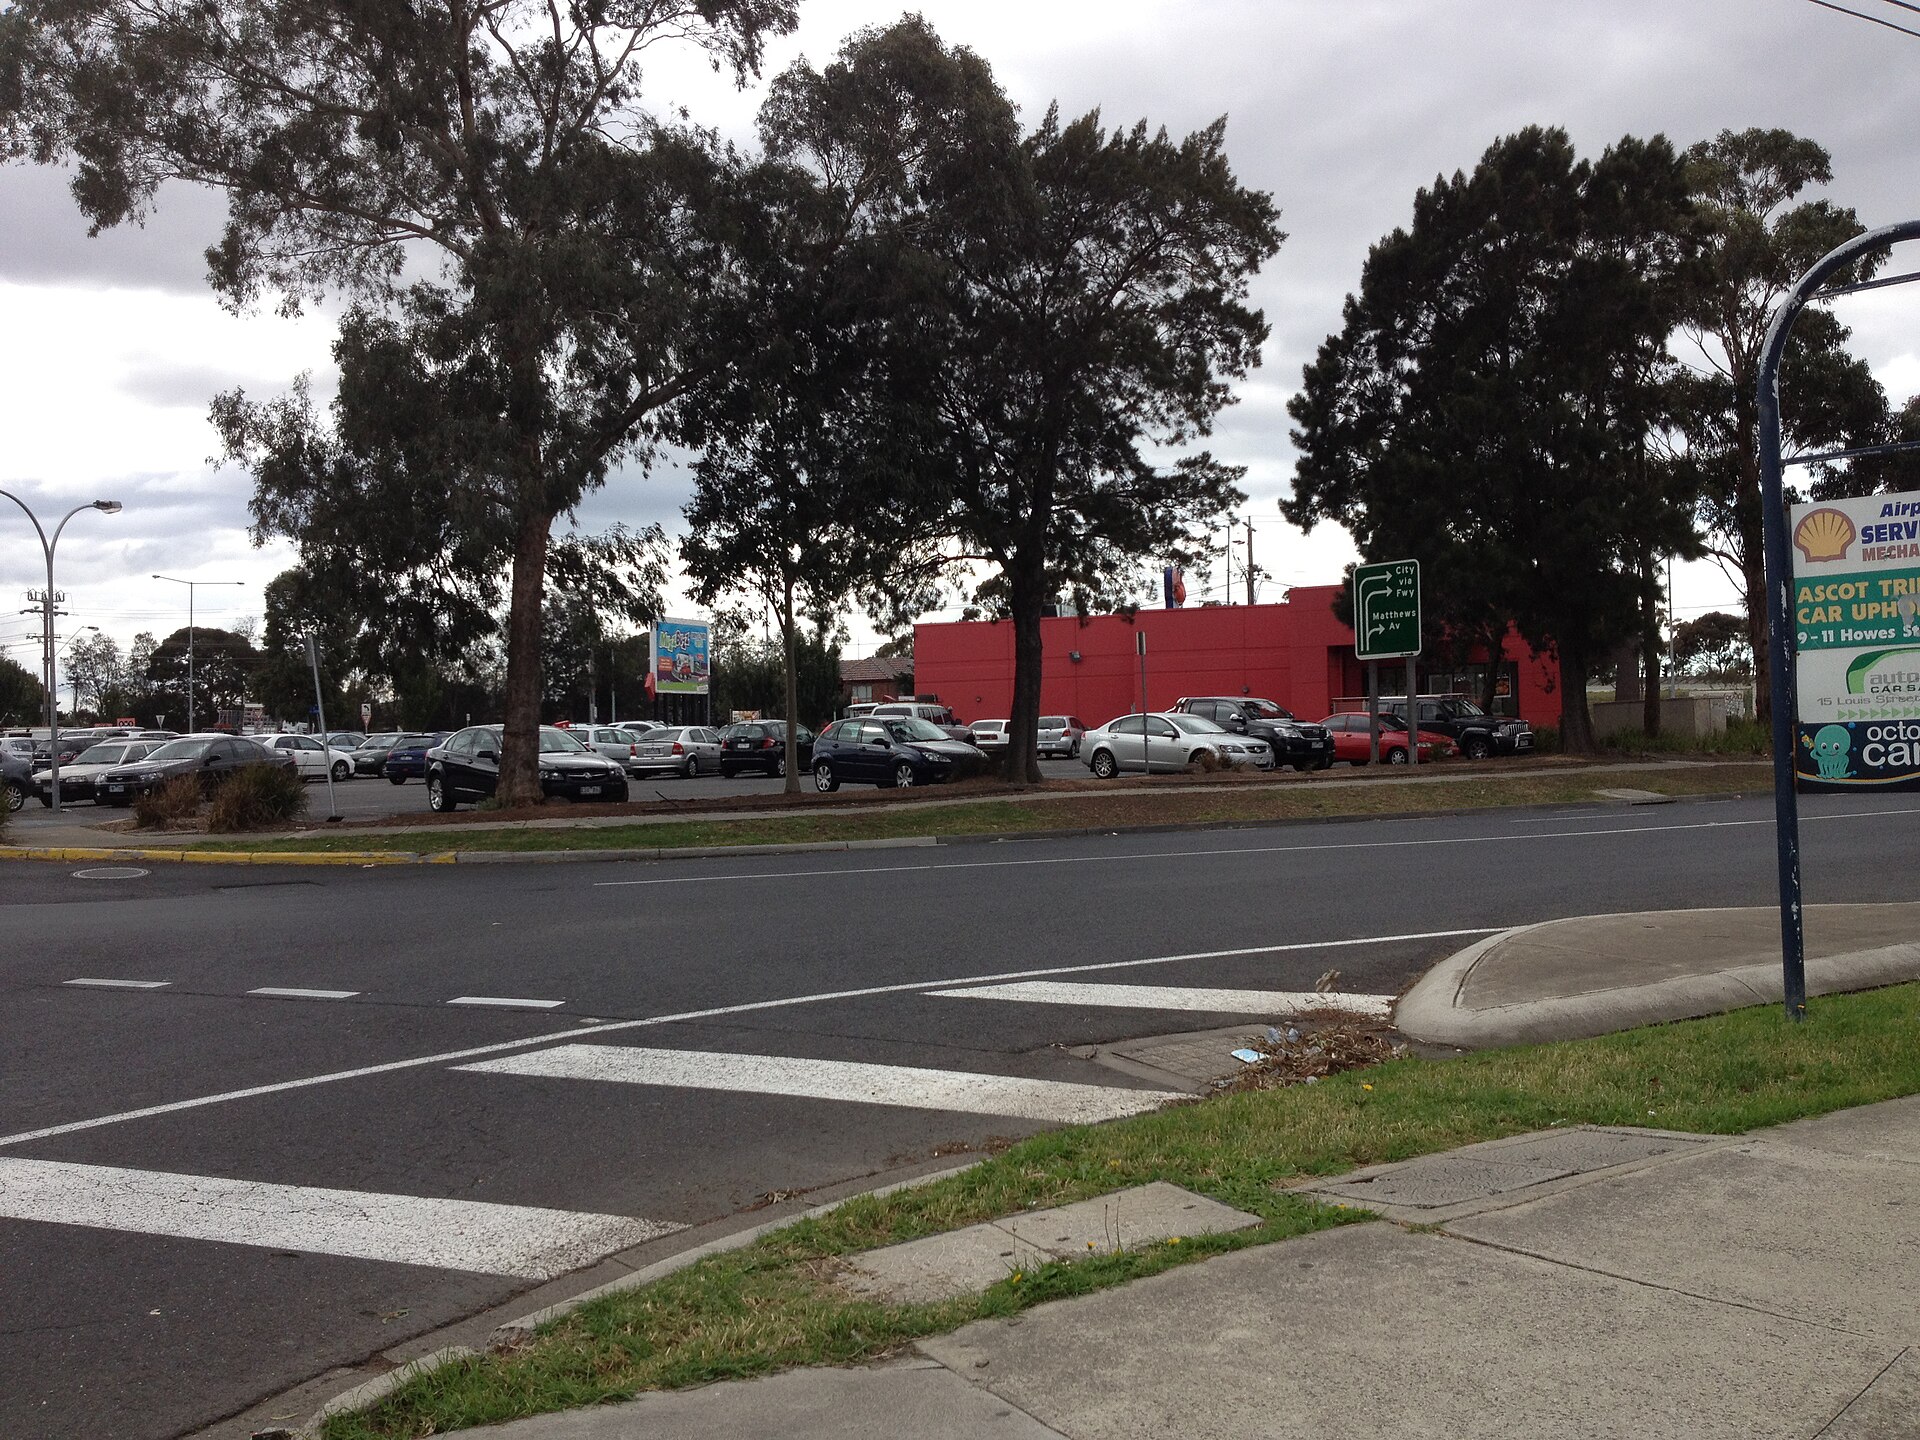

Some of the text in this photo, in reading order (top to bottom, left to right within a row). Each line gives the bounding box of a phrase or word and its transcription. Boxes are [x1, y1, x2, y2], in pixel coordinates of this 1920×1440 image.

[1880, 501, 1920, 518] Airp
[1861, 519, 1920, 545] SERV
[1862, 543, 1920, 562] MECHA
[1395, 566, 1415, 575] City
[1398, 577, 1413, 586] via
[1396, 588, 1415, 598] Fwy
[1797, 577, 1920, 604] ASCOT TRI
[1372, 609, 1417, 621] Matthews
[1797, 605, 1843, 625] CAR
[1389, 622, 1401, 631] Av
[1840, 628, 1896, 642] Howes
[1870, 671, 1920, 685] auto
[1870, 685, 1902, 694] CAR
[1817, 697, 1832, 706] 15
[1837, 695, 1871, 706] Louis
[1866, 720, 1920, 741] octo
